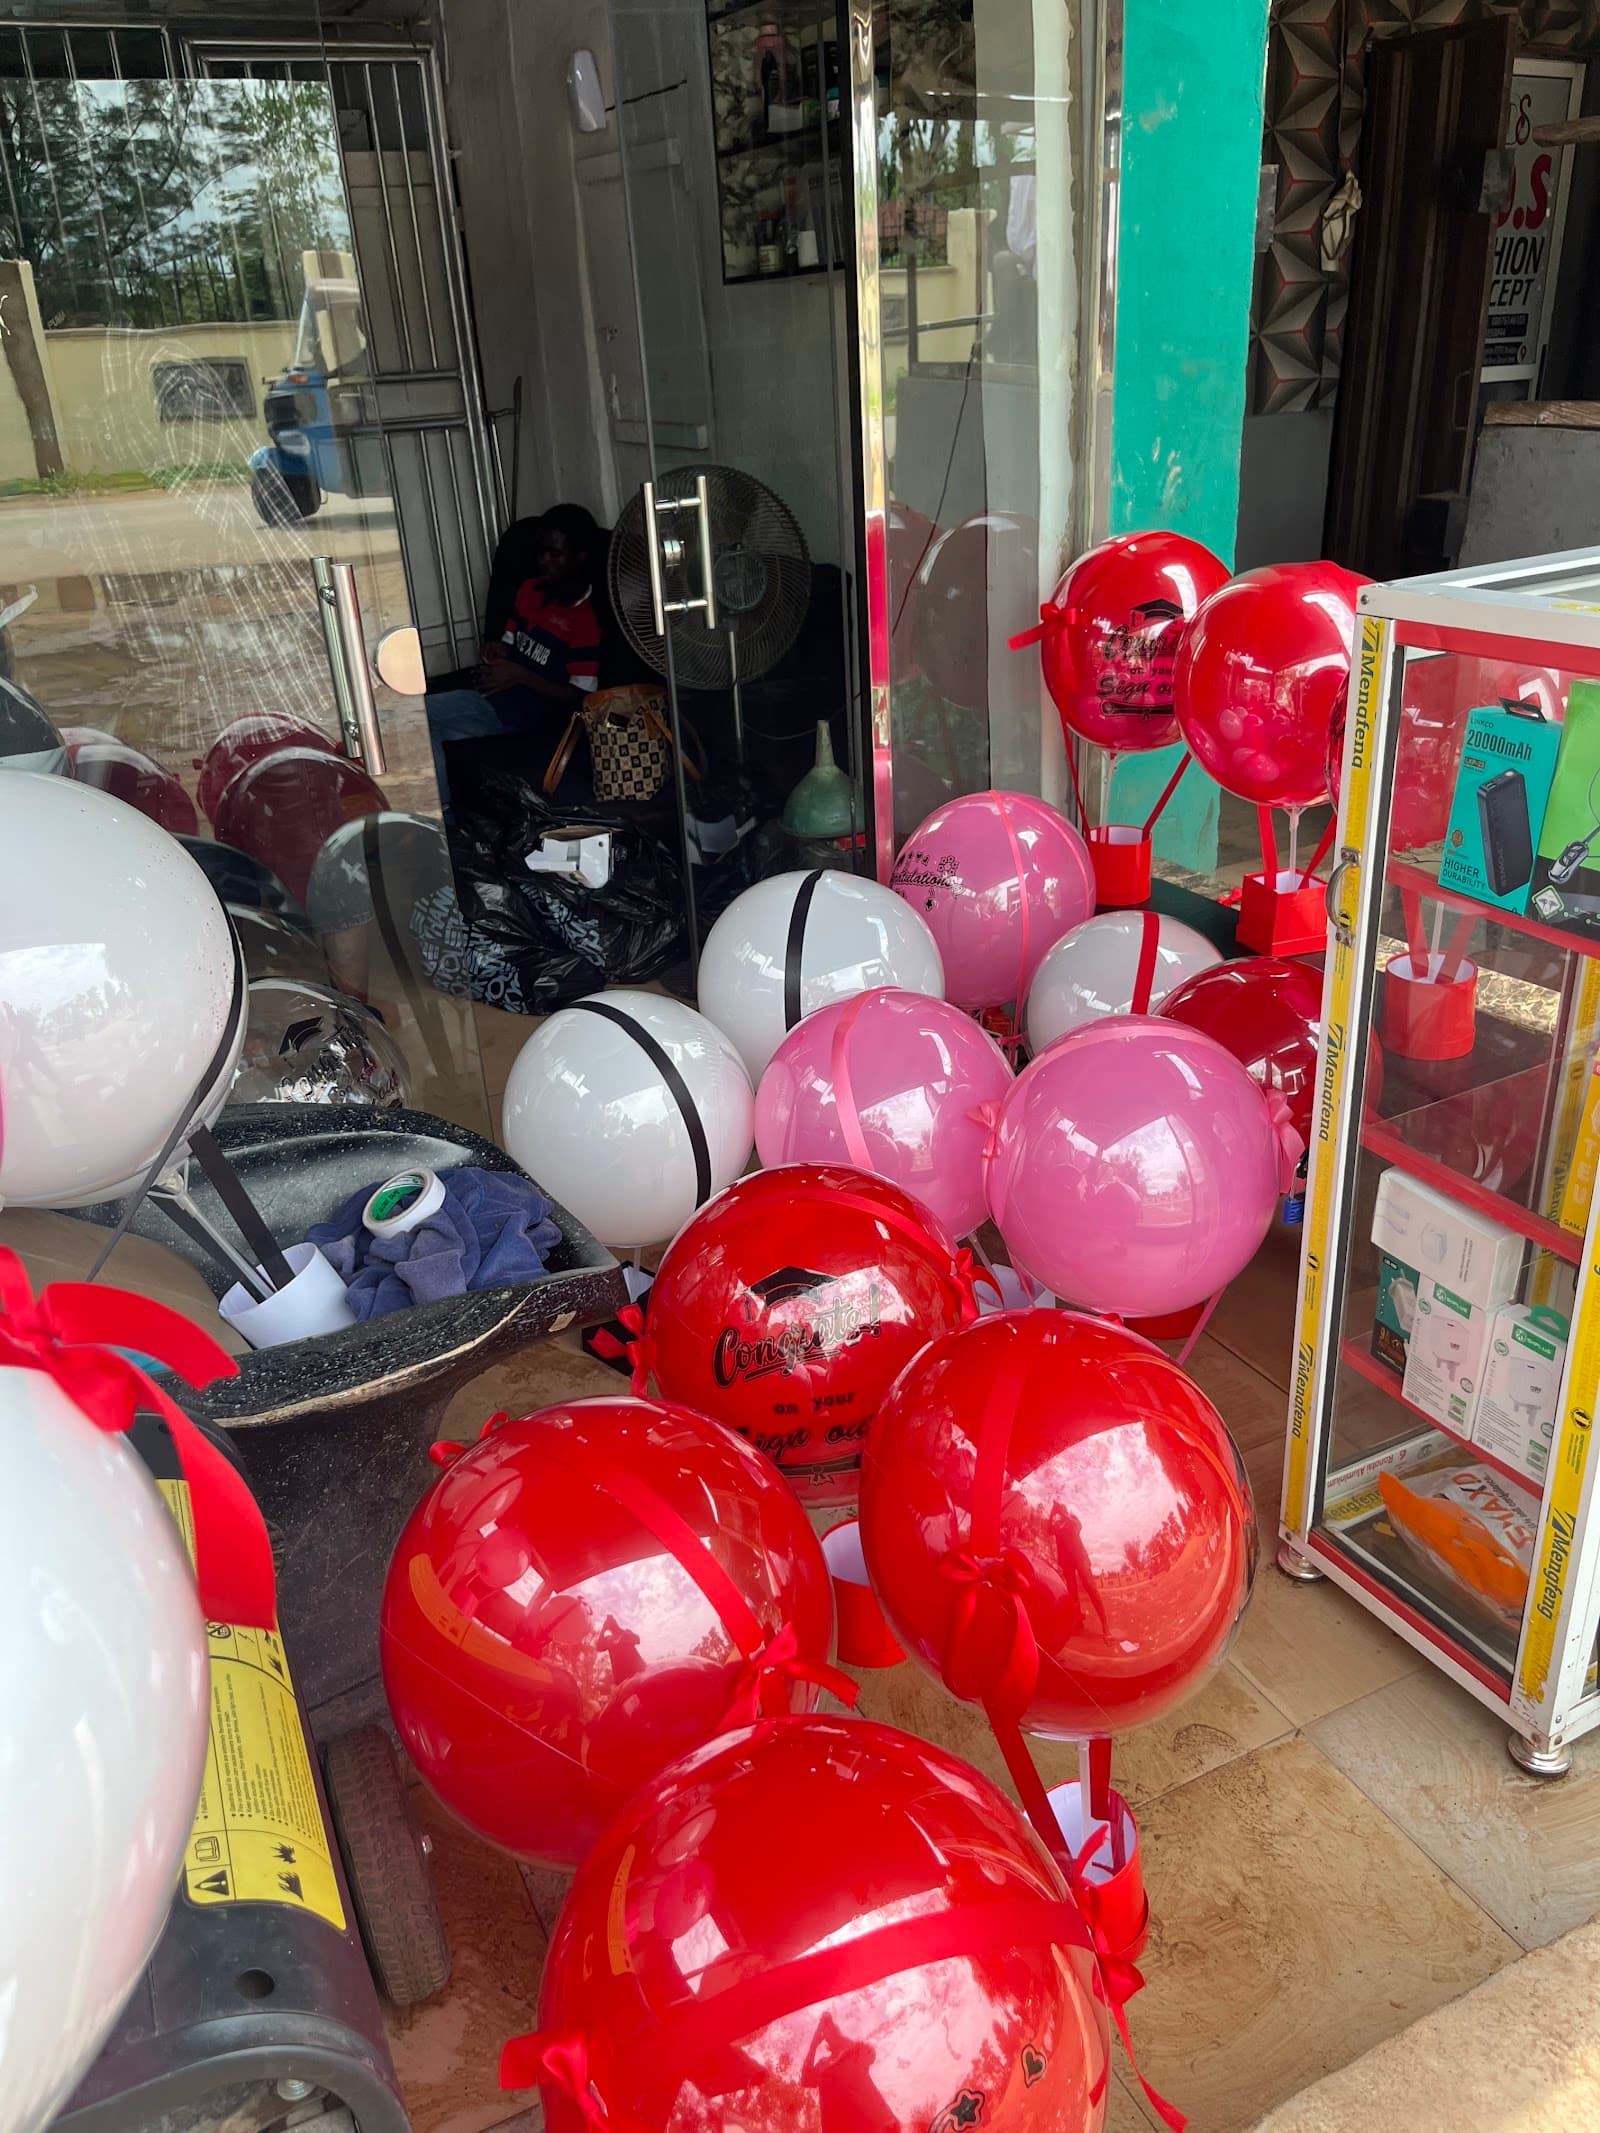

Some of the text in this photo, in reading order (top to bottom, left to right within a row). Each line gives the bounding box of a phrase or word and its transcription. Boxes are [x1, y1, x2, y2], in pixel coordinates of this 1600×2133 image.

[1466, 729, 1533, 761] 20000mAh
[1442, 868, 1486, 890] DURABILITY
[1444, 857, 1480, 879] HIGHER
[812, 1391, 857, 1411] your
[1537, 1531, 1574, 1620] Mengfeng
